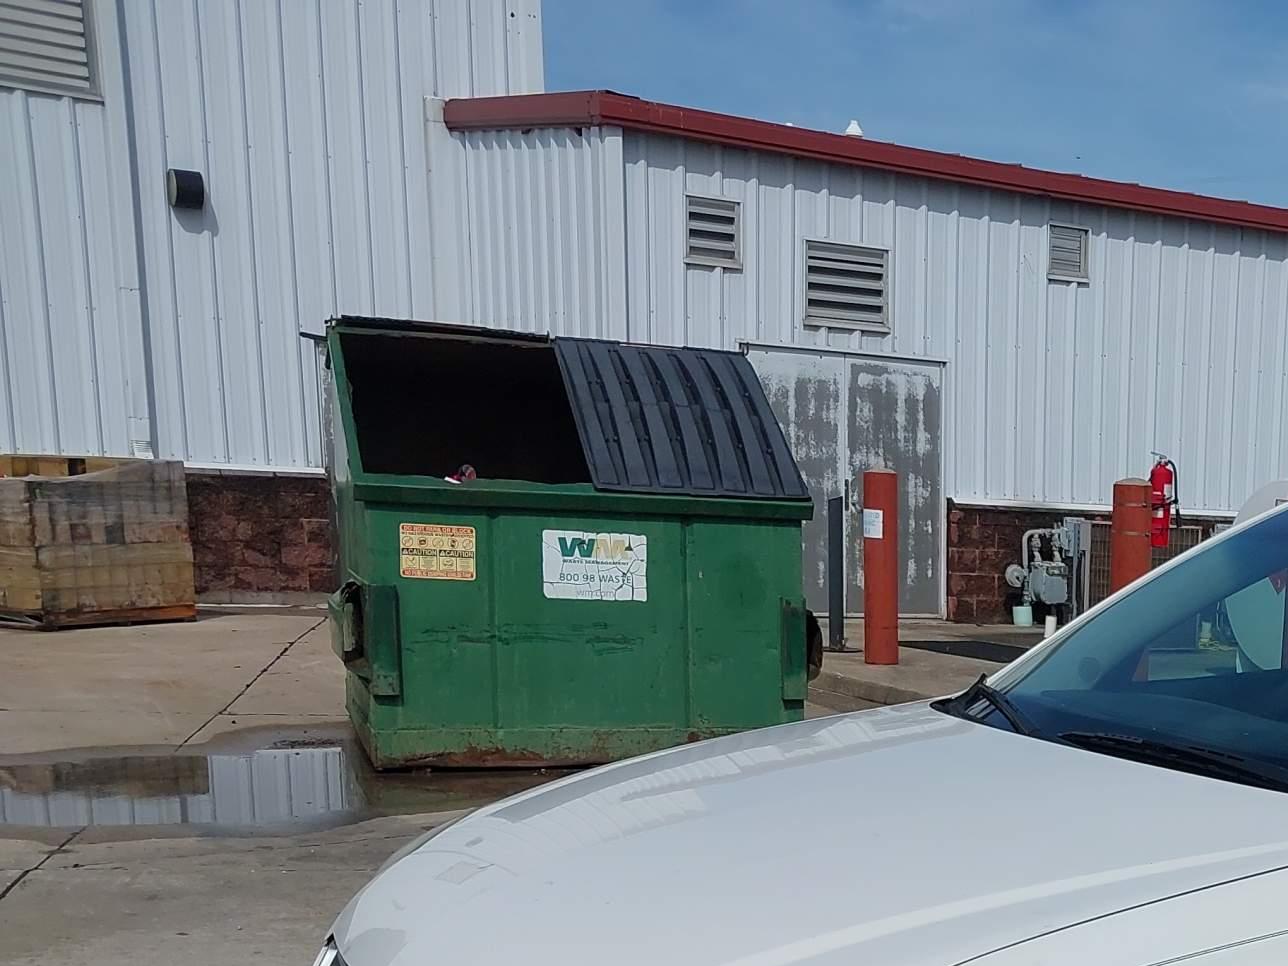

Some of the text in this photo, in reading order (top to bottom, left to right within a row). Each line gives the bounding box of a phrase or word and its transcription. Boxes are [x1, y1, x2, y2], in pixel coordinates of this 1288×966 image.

[446, 550, 473, 558] CAUTION
[559, 573, 632, 584] 800 98 WASTE
[576, 589, 614, 598] wm.com
